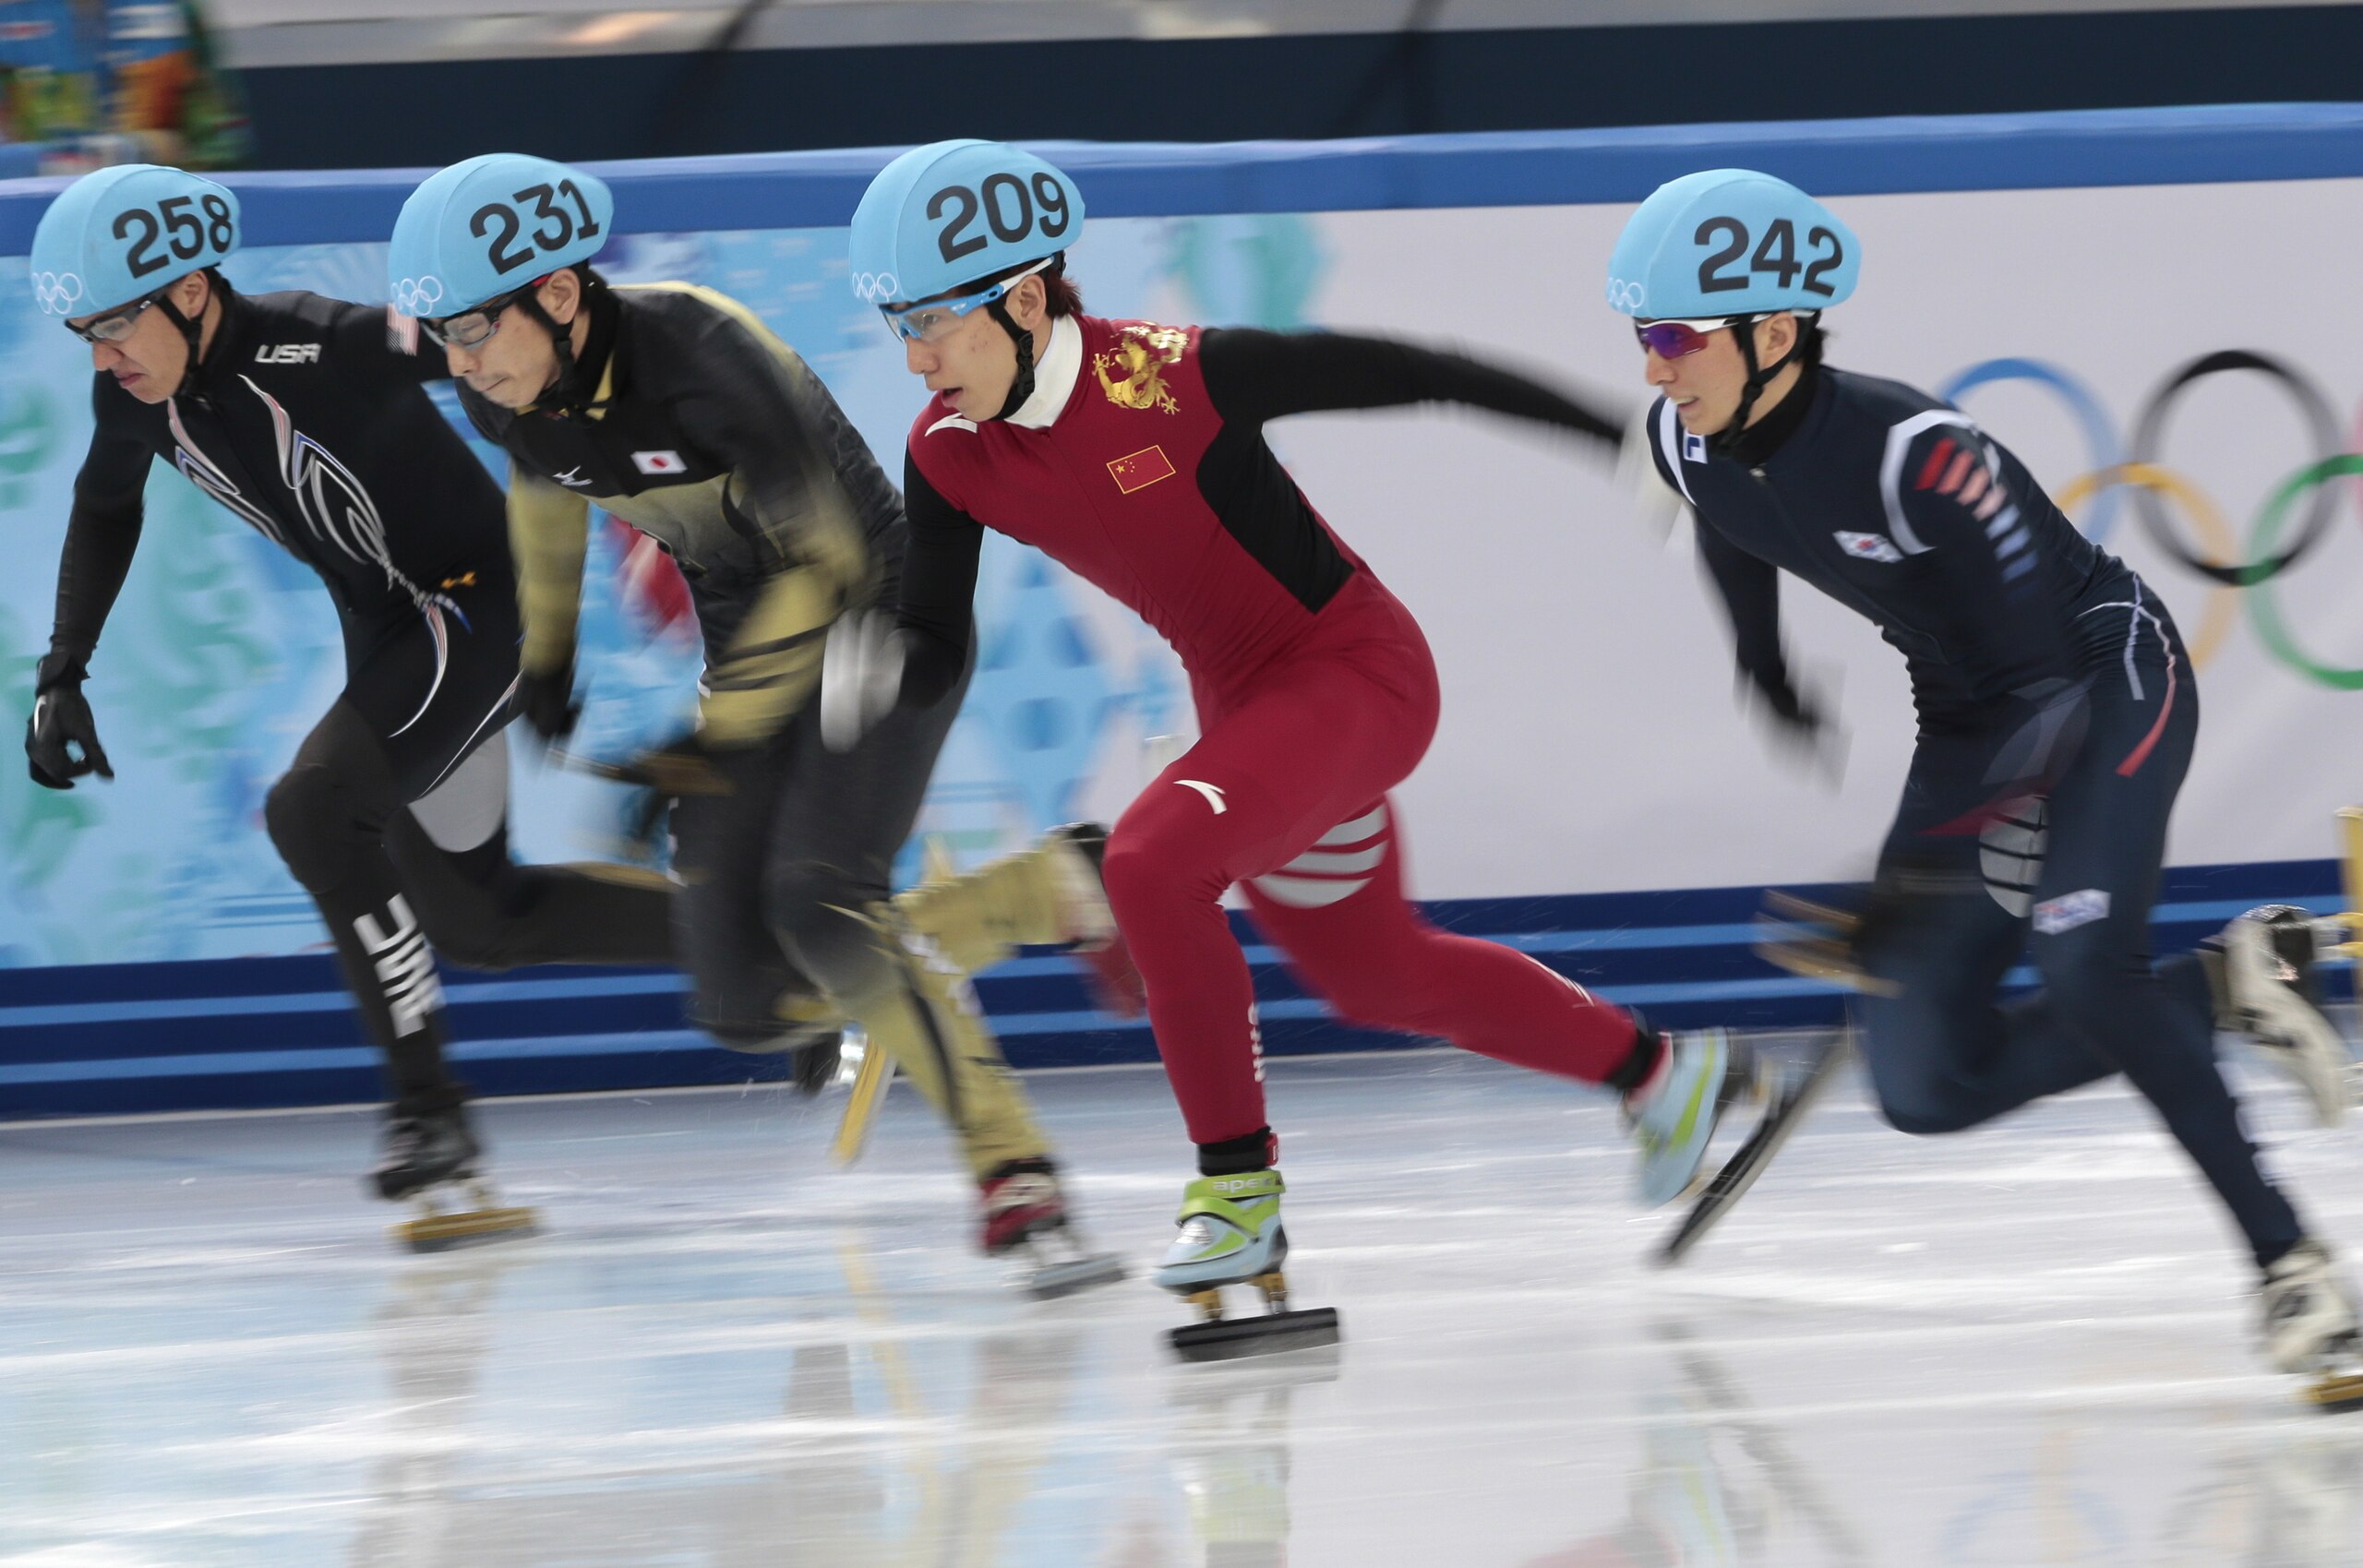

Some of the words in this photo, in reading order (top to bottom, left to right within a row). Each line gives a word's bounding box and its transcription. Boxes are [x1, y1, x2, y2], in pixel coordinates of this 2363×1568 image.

[112, 194, 234, 280] 258
[469, 178, 600, 276] 231
[926, 172, 1070, 264] 209
[1694, 215, 1843, 297] 242
[255, 343, 321, 364] USA
[353, 892, 447, 1039] USA
